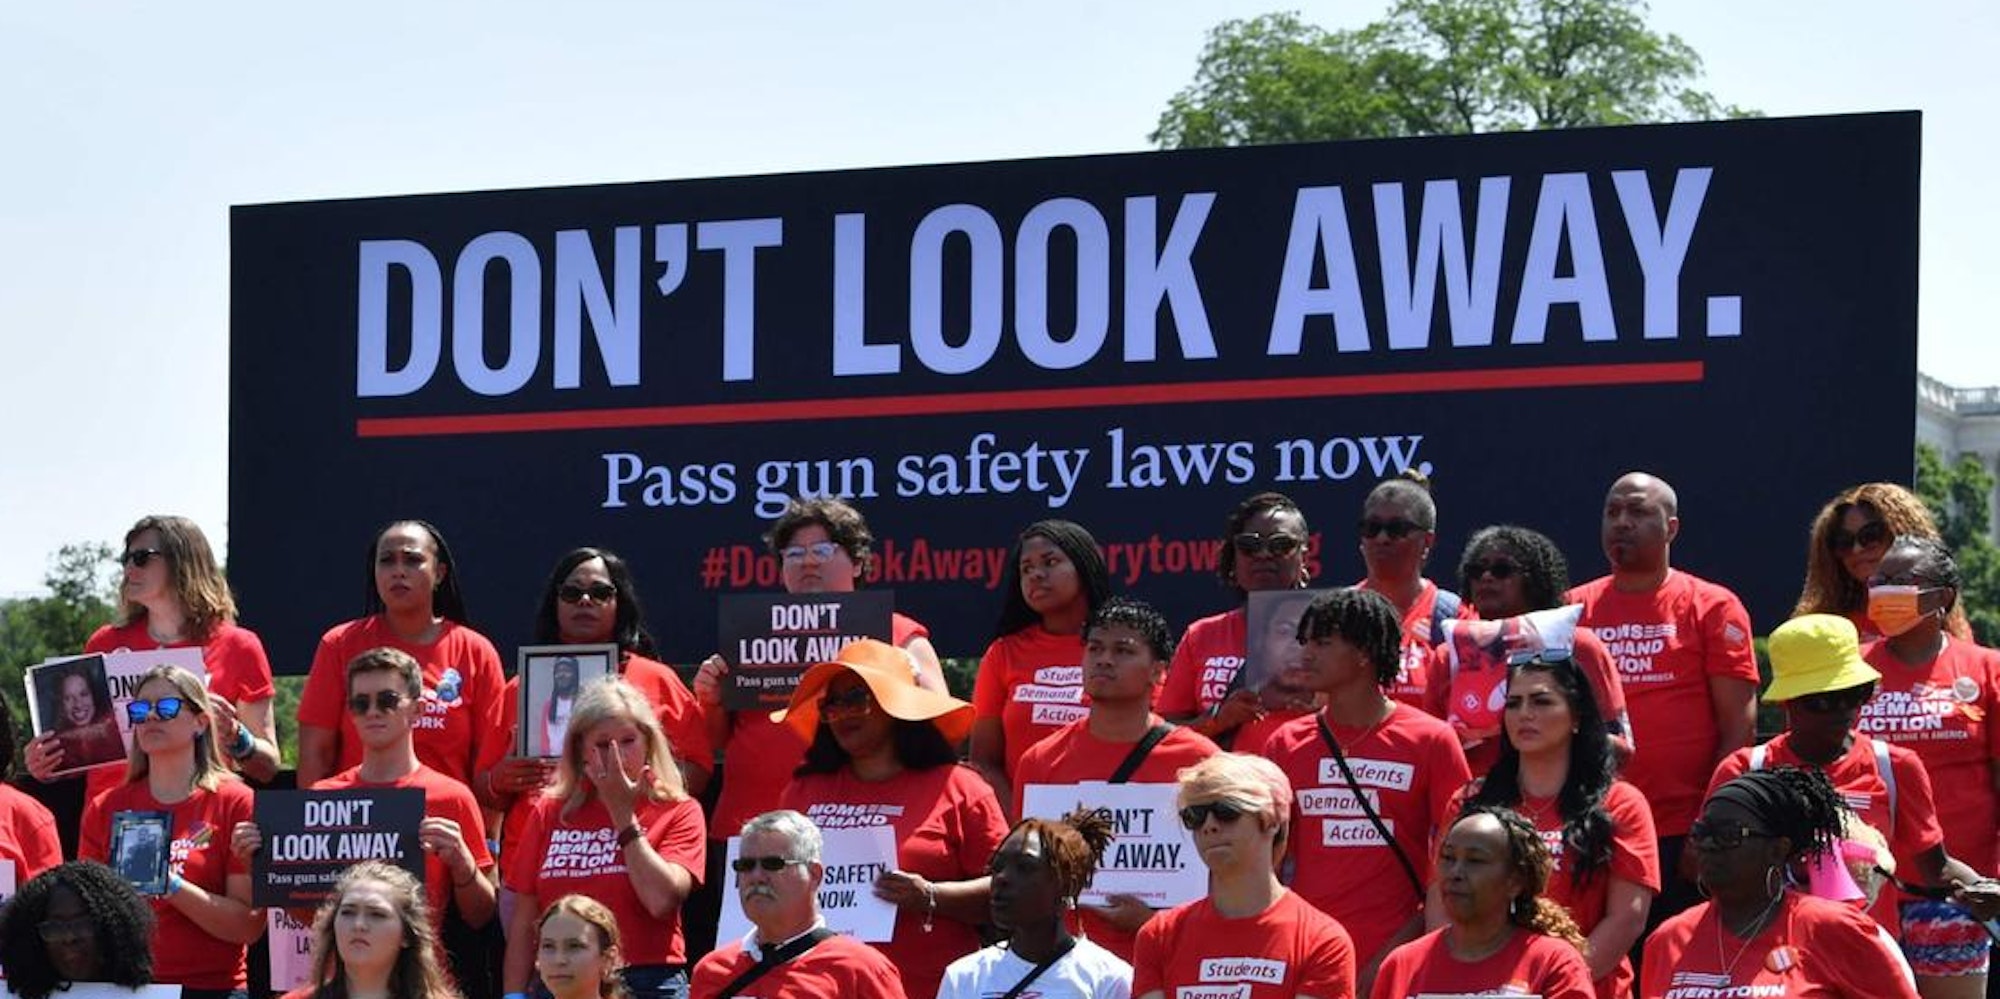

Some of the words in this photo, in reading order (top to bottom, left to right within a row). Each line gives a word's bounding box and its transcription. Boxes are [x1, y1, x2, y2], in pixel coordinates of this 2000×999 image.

[358, 219, 783, 397] DON'T
[834, 193, 1218, 376] LOOK
[1268, 168, 1741, 355] AWAY.
[603, 454, 737, 507] Pass
[754, 456, 879, 518] gun
[897, 433, 1090, 508] safety
[1108, 429, 1255, 488] laws
[1275, 435, 1433, 480] now.
[771, 603, 841, 631] DON'T
[738, 638, 798, 665] LOOK
[1018, 687, 1077, 699] Demand
[1860, 700, 1955, 716] DEMAND
[1858, 715, 1943, 732] ACTION
[304, 799, 374, 827] DON'T
[551, 828, 612, 843] MOMS
[272, 833, 331, 861] LOOK
[336, 832, 404, 860] AWAY.
[547, 840, 622, 856] DEMAN
[541, 852, 617, 870] ACTION
[1114, 843, 1185, 869] AWAY.
[267, 872, 292, 884] Pass
[294, 873, 316, 886] gun
[1207, 962, 1278, 978] Students
[1666, 984, 1785, 999] EVERYTOWN
